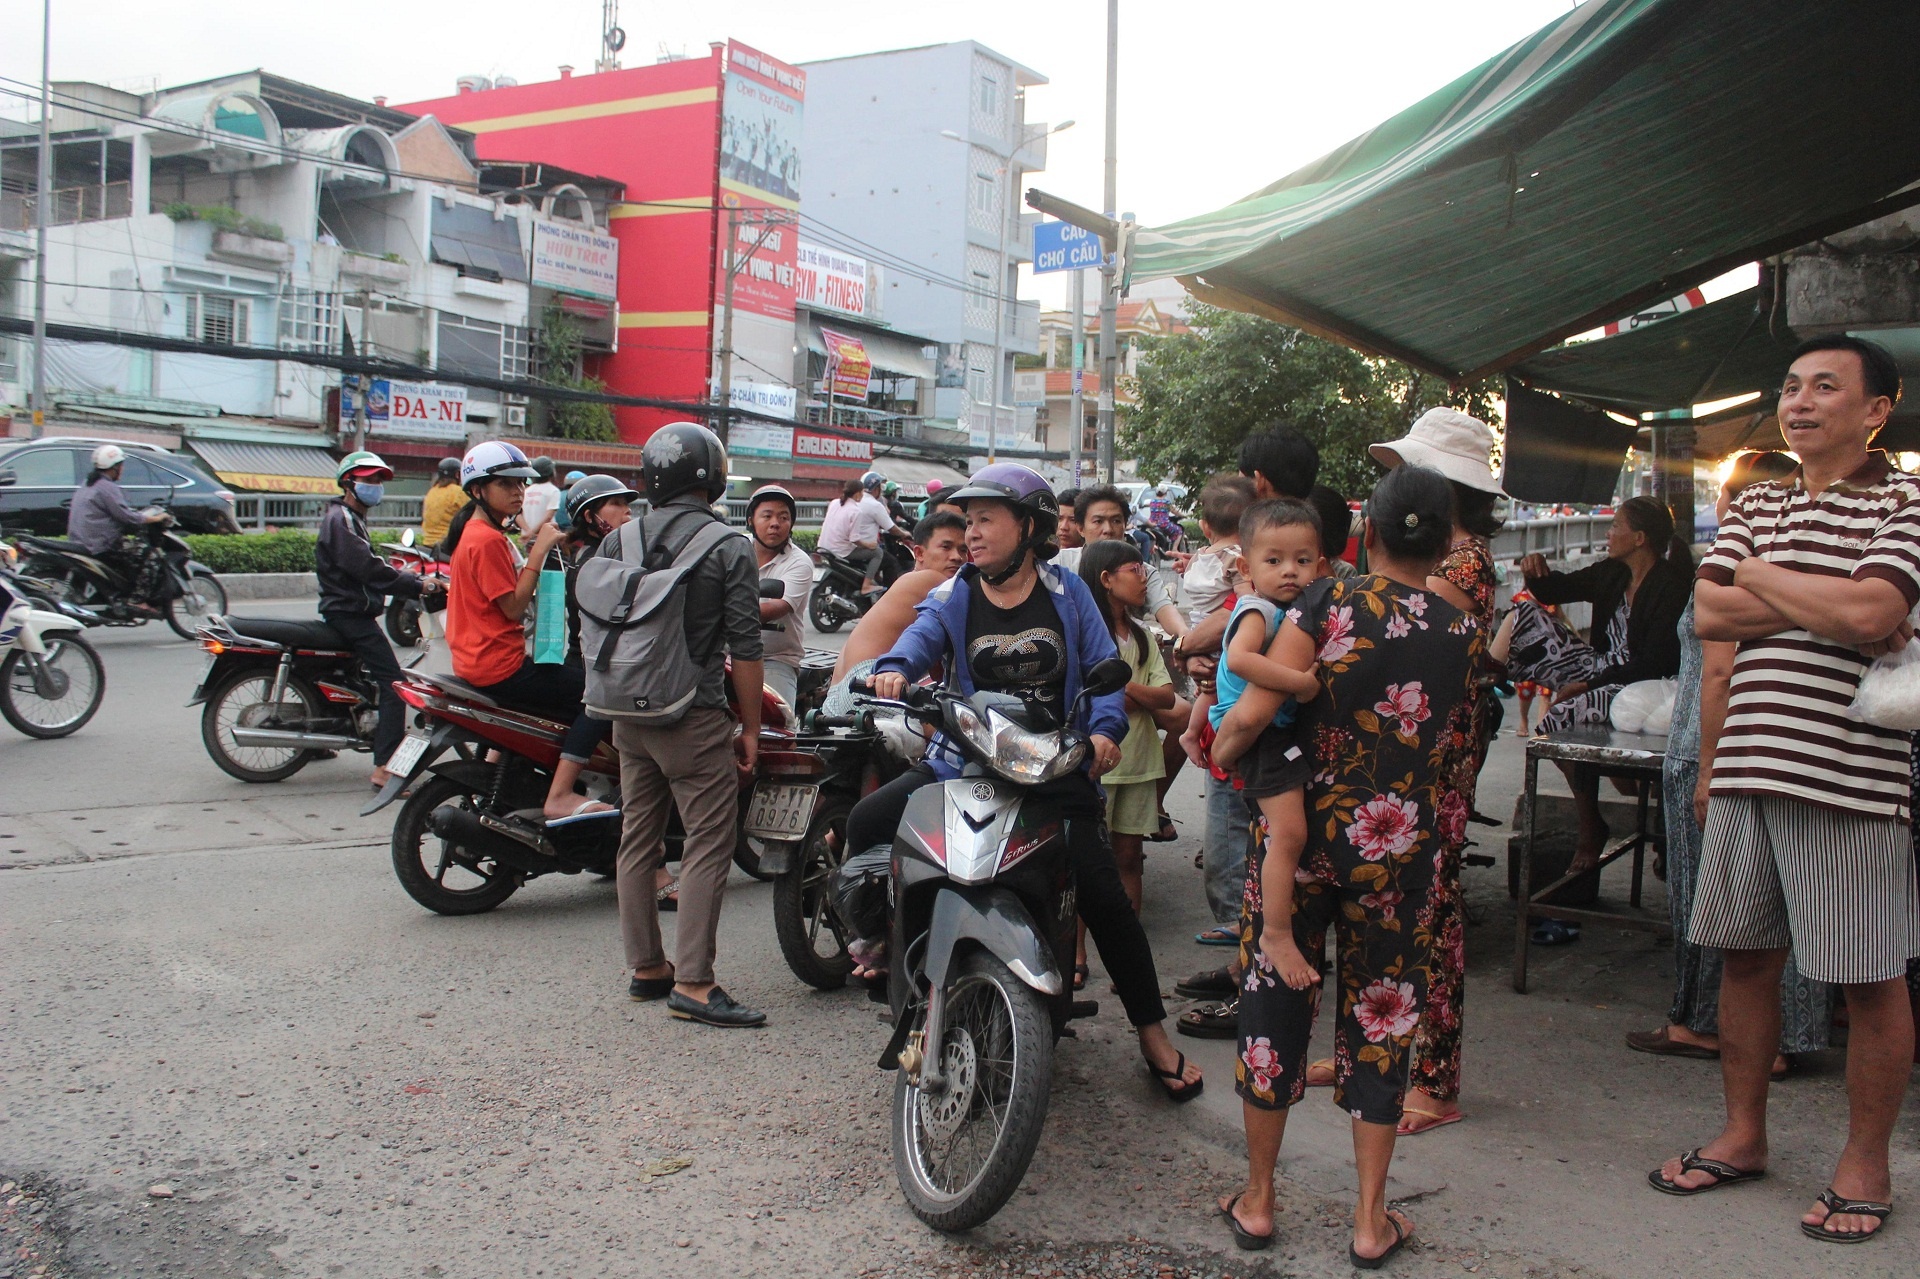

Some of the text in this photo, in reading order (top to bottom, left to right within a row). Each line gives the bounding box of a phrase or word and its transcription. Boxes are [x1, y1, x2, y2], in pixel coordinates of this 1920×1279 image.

[737, 80, 795, 115] Open Your Future
[1038, 241, 1097, 269] CHỢ CẦU
[749, 256, 774, 282] VỌNG
[775, 261, 796, 289] VIỆT
[796, 267, 817, 302] GYM
[825, 274, 864, 313] FITNESS
[421, 385, 442, 398] KHÁM
[738, 384, 756, 404] CHẨN
[769, 391, 787, 407] ĐÔNG
[788, 396, 793, 407] Y
[796, 435, 837, 457] ENGLISH
[837, 439, 872, 460] SCHOOL
[463, 465, 476, 477] TOA
[265, 479, 286, 492] XE
[756, 807, 800, 829] 0976
[1002, 838, 1039, 864] SIRIUS
